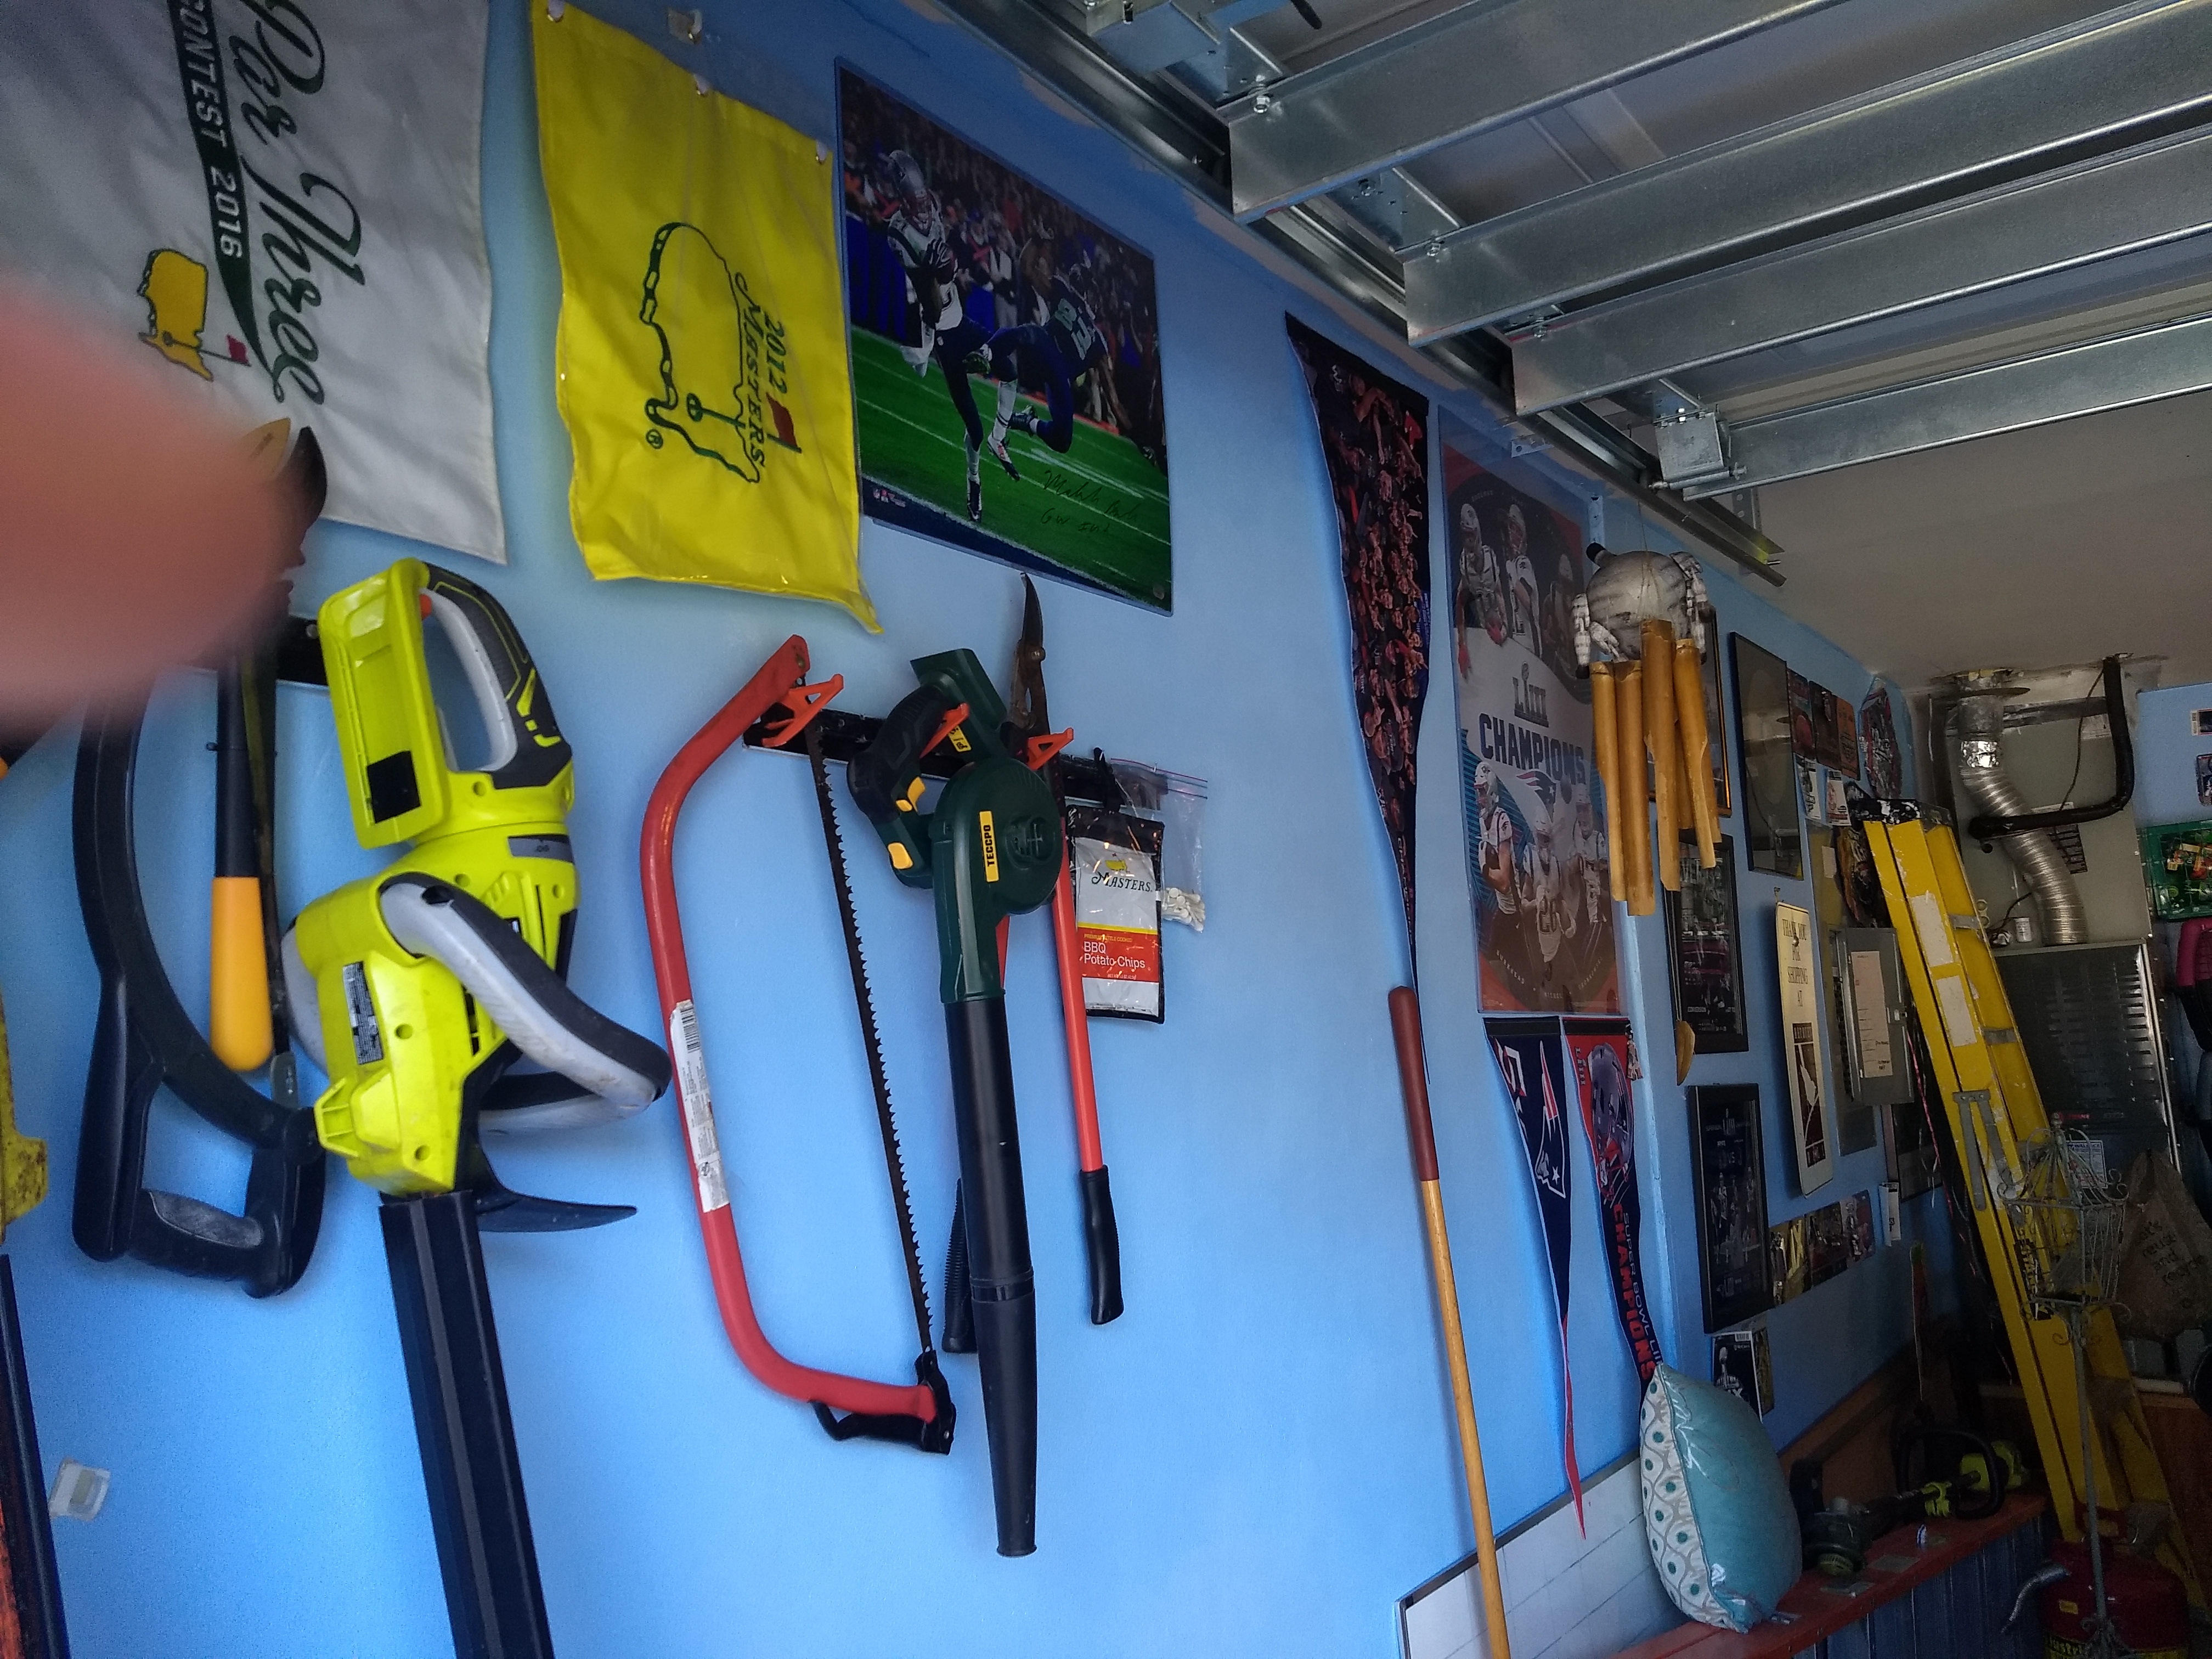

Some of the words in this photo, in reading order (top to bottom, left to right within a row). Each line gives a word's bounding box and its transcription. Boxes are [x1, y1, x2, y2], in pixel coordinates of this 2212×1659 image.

[229, 0, 326, 145] Par
[209, 166, 244, 258] 2016
[242, 156, 365, 404] Three
[735, 272, 766, 468] MASTERS
[761, 311, 788, 394] 2012
[1479, 713, 1587, 786] CHAMPIONS
[984, 825, 995, 867] TECCPO
[1091, 871, 1150, 892] MASTERS
[1084, 941, 1106, 954] BBQ
[1084, 953, 1115, 966] Potato
[1117, 956, 1146, 970] Chips
[1787, 966, 1808, 985] SHOPPING
[1797, 990, 1803, 1007] AT
[1613, 1202, 1657, 1380] CHAMPIONS
[1623, 1212, 1637, 1276] SUPER
[1633, 1281, 1651, 1336] BOWL
